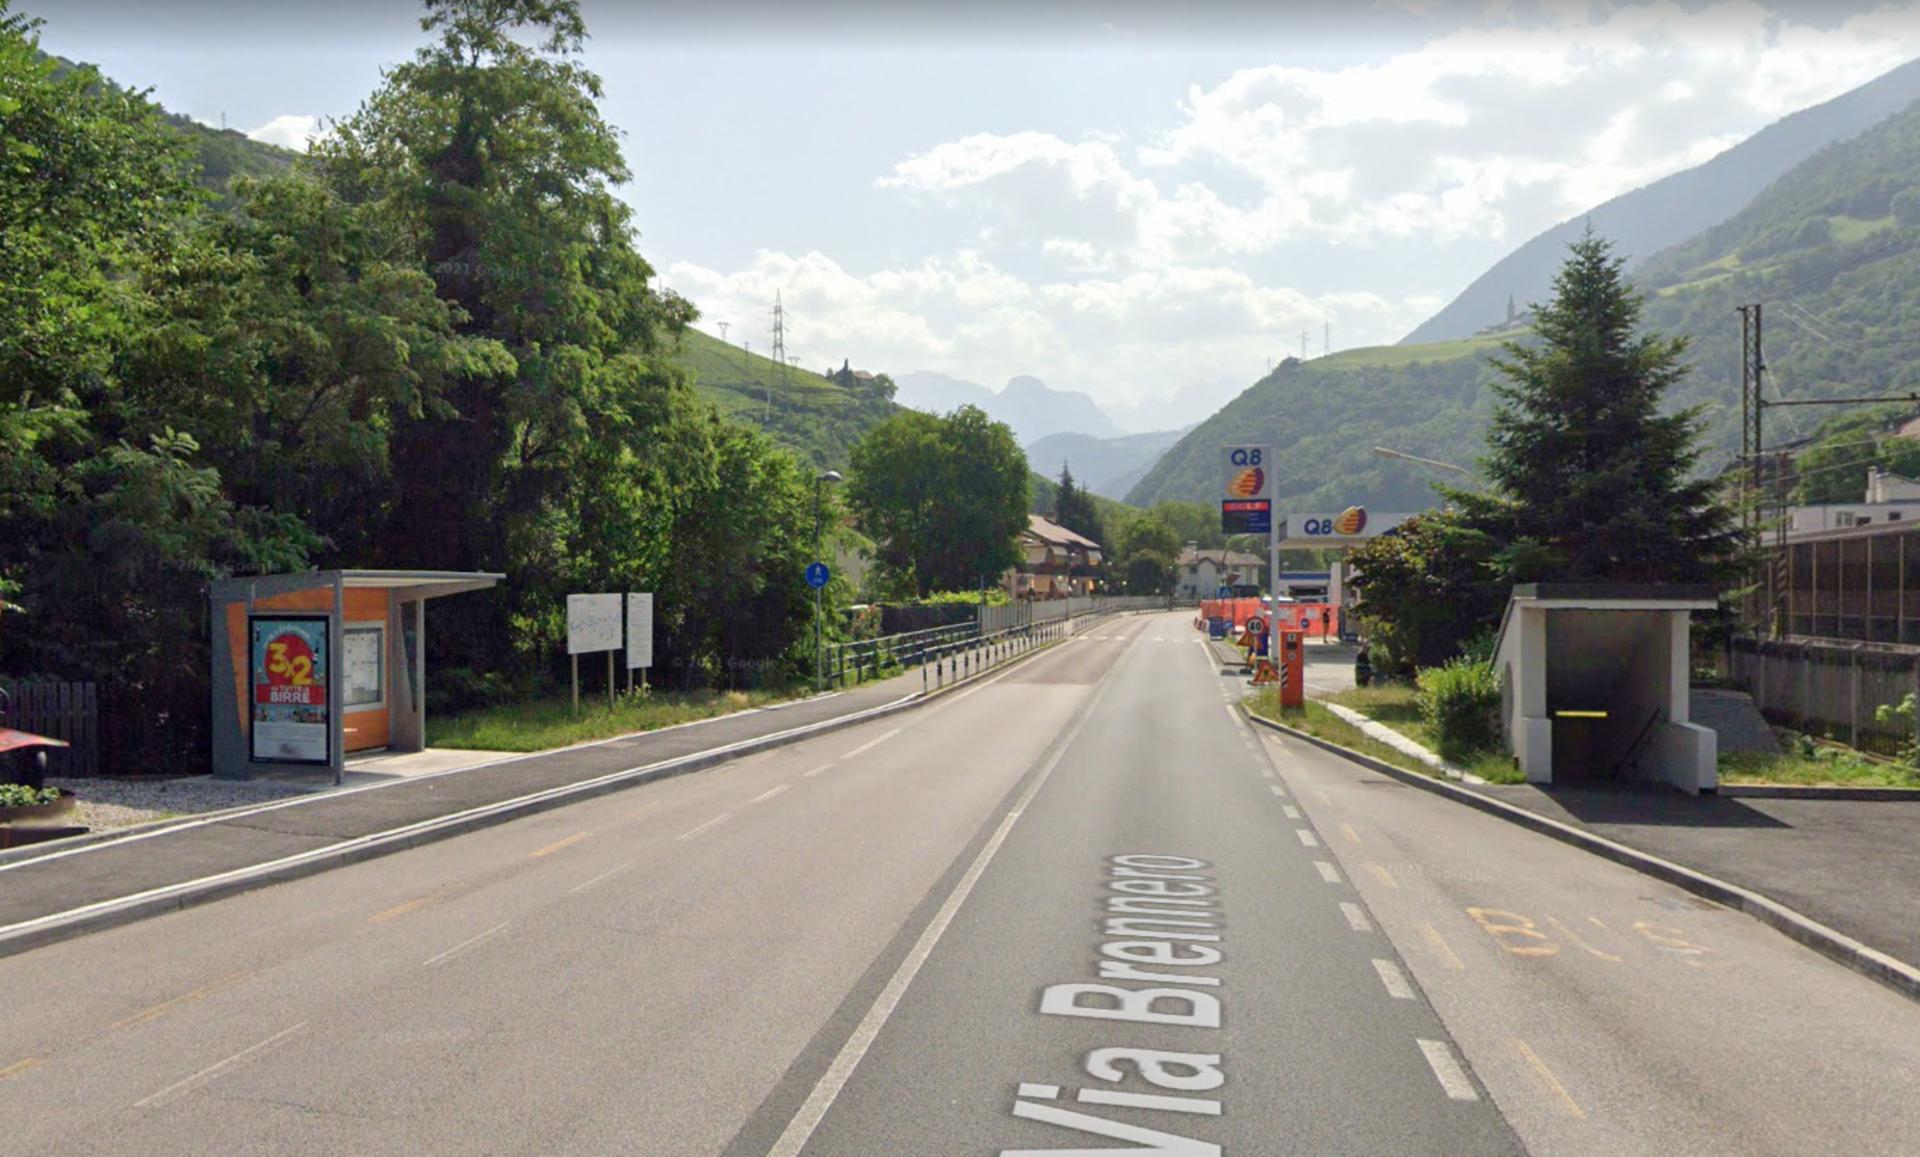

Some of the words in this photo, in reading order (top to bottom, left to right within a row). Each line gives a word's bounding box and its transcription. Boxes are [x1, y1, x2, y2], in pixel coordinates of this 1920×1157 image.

[1231, 449, 1262, 466] Q8
[1304, 519, 1332, 535] Q8
[1249, 622, 1262, 631] 40
[270, 691, 310, 703] BIRRE
